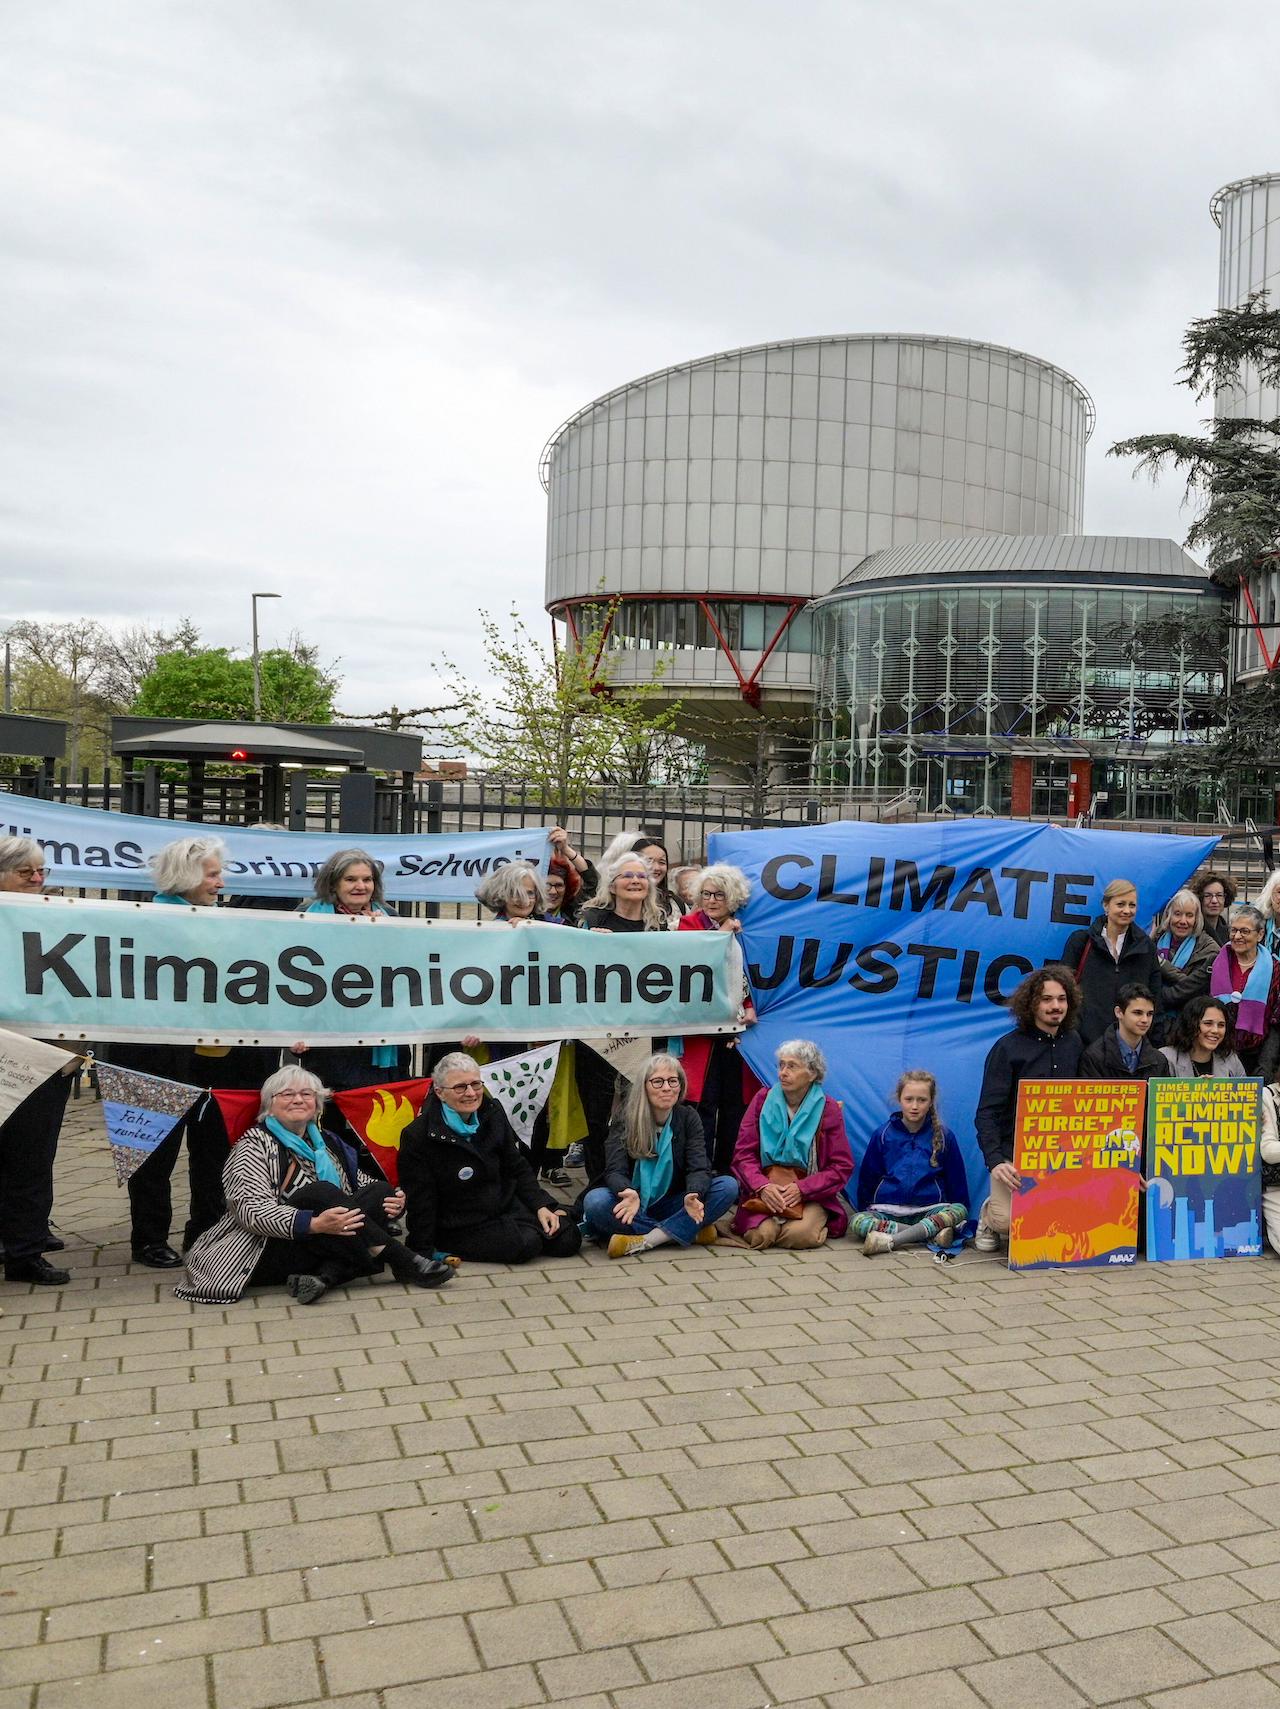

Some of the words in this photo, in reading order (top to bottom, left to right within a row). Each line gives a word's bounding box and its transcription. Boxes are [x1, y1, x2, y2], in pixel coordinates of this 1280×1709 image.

[761, 854, 1094, 926] CLIMATE
[22, 931, 713, 1008] KlimaSeniorinnen
[748, 935, 1066, 1007] JUSTIC
[1024, 1085, 1040, 1095] TO
[1046, 1085, 1072, 1095] OUR
[1077, 1085, 1140, 1095] LEADERS:
[1195, 1083, 1209, 1091] UP
[1213, 1083, 1233, 1091] FOR
[1237, 1083, 1258, 1091] OUR
[1026, 1098, 1062, 1113] WE
[1156, 1091, 1258, 1103] GOVERNMENTS:
[120, 1109, 152, 1126] Fahr
[1156, 1103, 1257, 1121] CLIMATE
[1023, 1115, 1114, 1132] FORGET
[1023, 1135, 1060, 1149] WE
[1155, 1122, 1256, 1145] ACTION
[1021, 1151, 1082, 1170] GIVE
[1092, 1150, 1137, 1169] UP!
[1154, 1143, 1256, 1176] NOW!
[1108, 1254, 1135, 1263] AVAAZ
